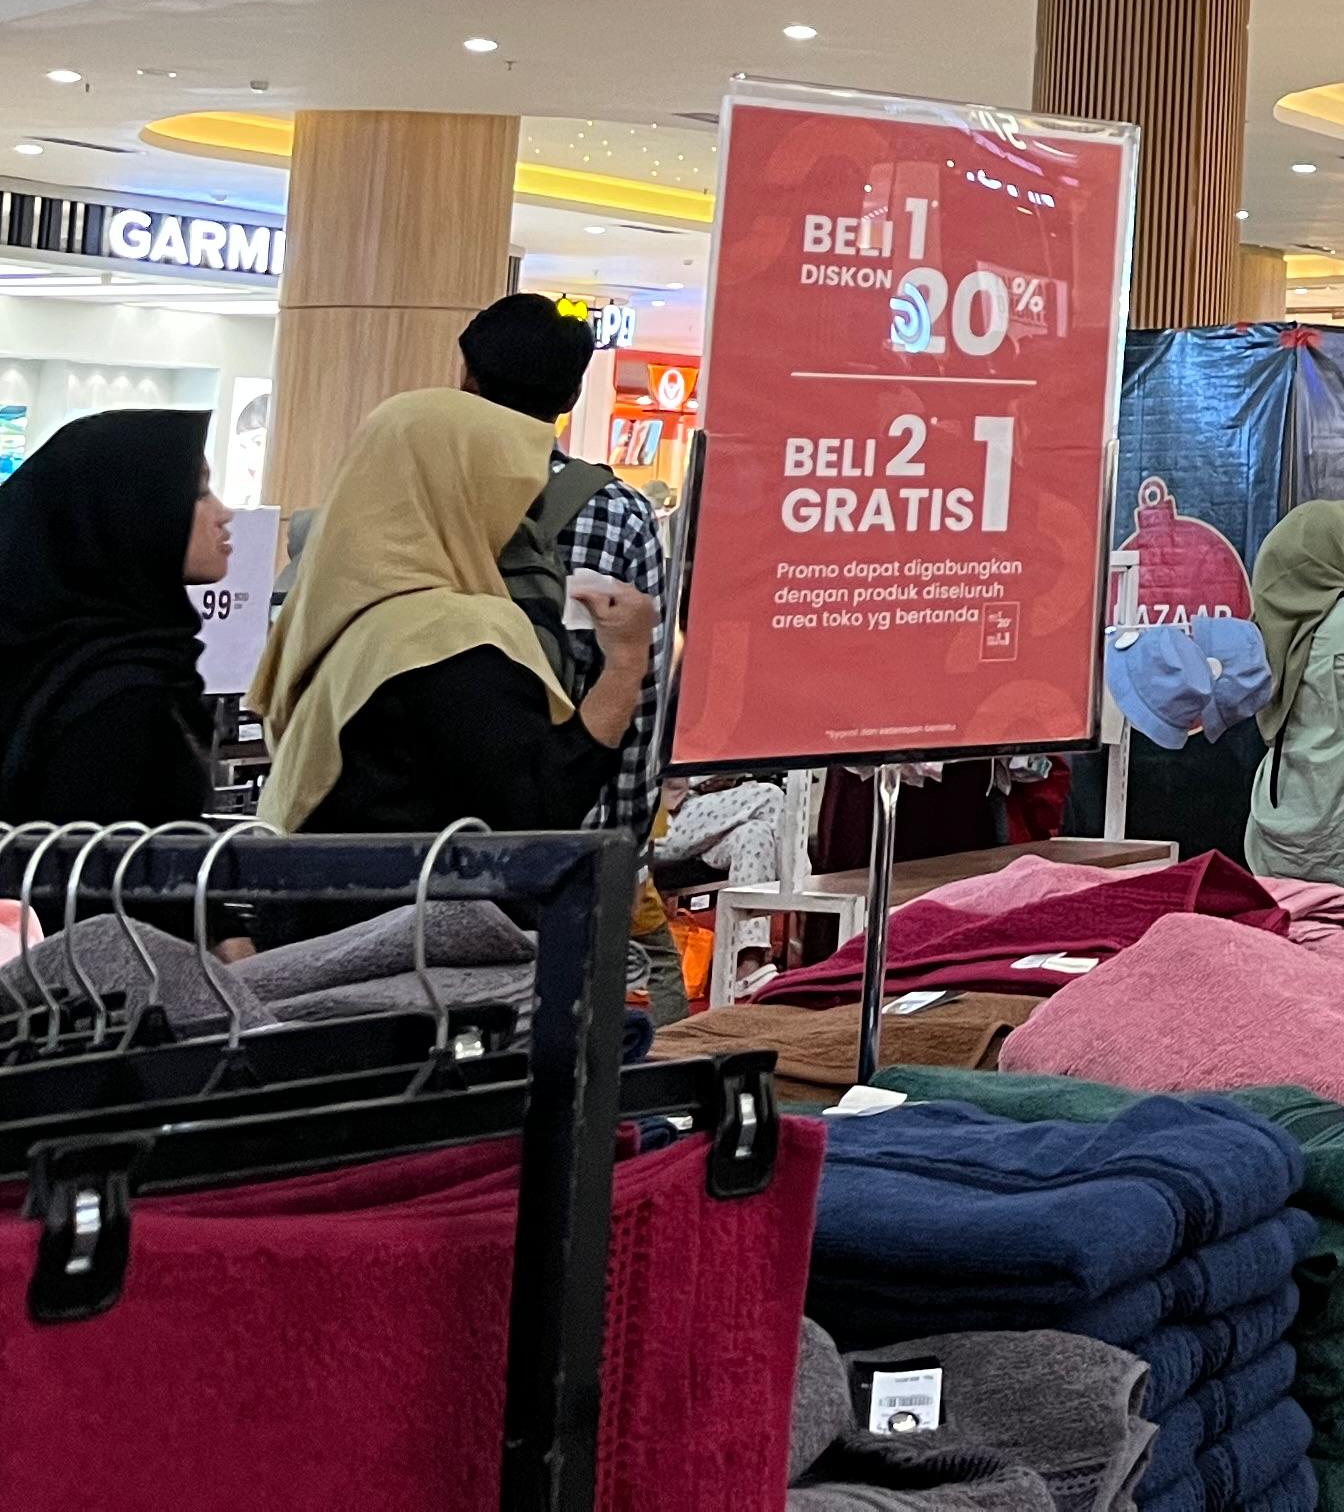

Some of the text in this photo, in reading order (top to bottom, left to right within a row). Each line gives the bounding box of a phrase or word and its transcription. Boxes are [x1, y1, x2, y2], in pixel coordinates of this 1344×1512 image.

[803, 214, 894, 258] BELI
[801, 263, 894, 289] DISKON
[783, 437, 877, 477] BELI
[781, 415, 1015, 533] GRATIS 1
[776, 557, 1023, 582] Promo dapat digabungkan
[202, 589, 232, 620] 99
[774, 581, 1005, 608] dengan produk diseluruh
[772, 605, 980, 631] area toko yg bertanda
